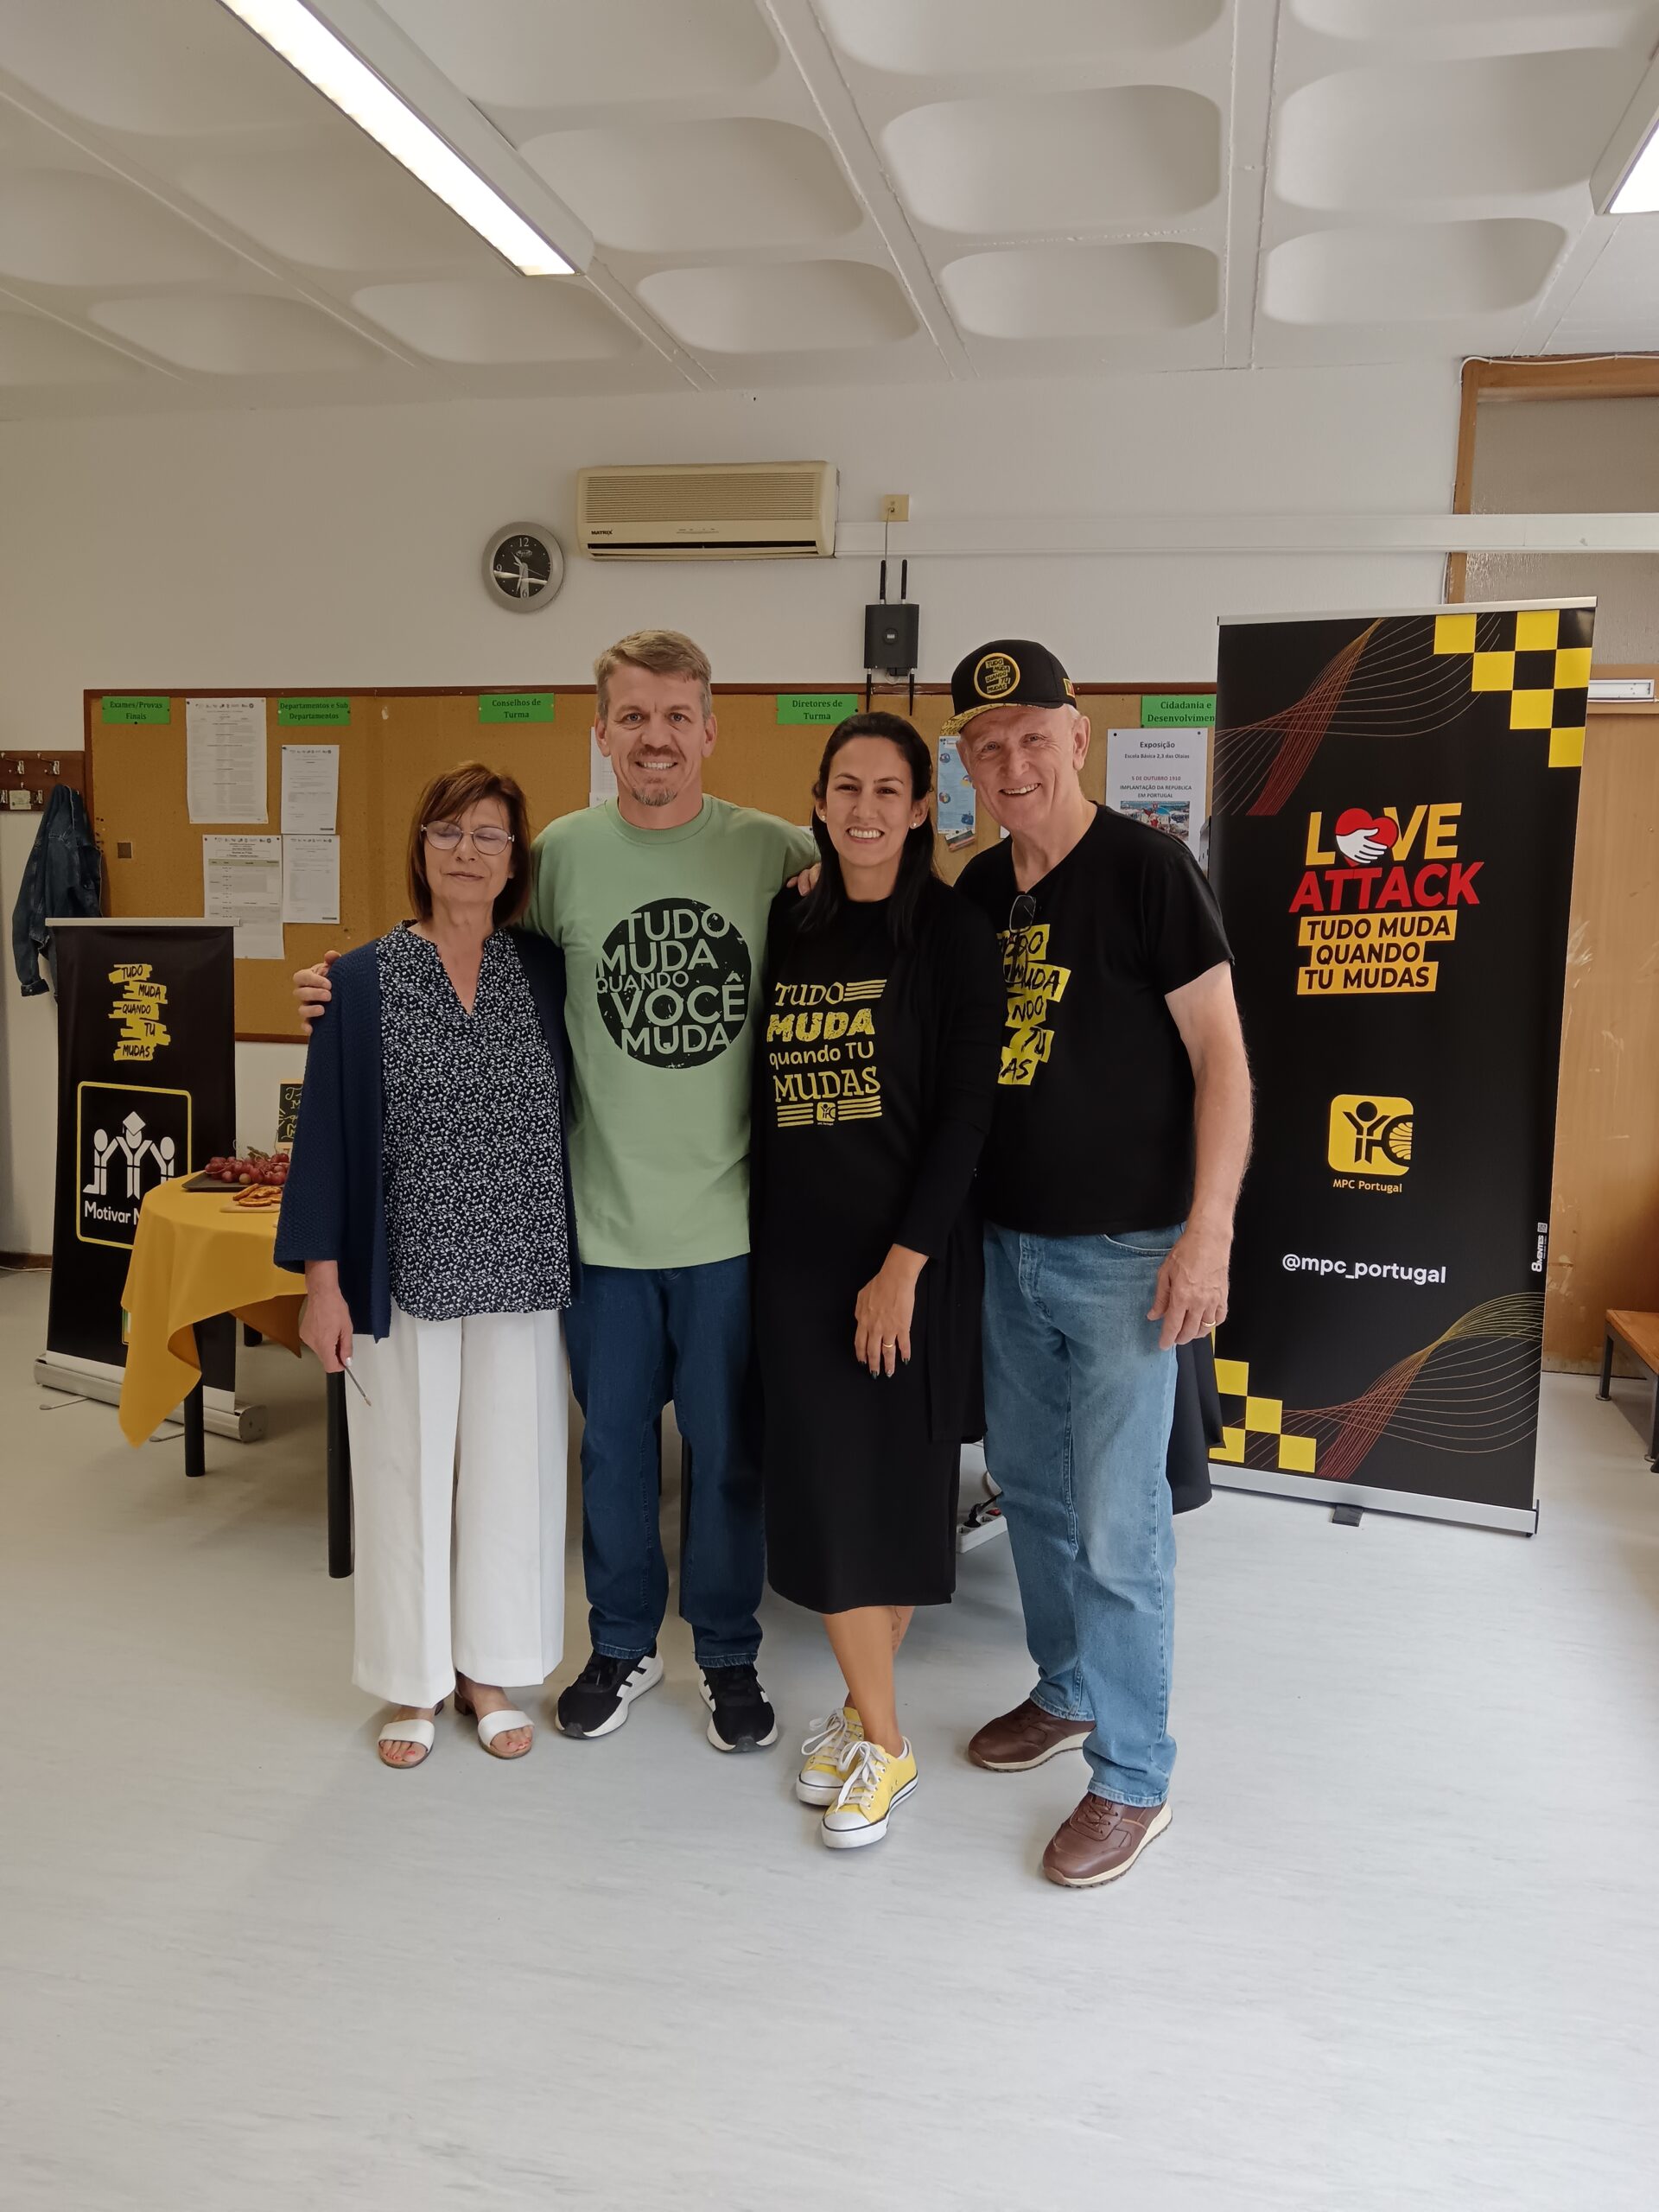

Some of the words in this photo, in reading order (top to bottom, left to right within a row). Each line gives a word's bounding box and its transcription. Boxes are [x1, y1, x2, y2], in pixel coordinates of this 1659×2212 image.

[518, 537, 529, 547] 12
[1147, 714, 1215, 722] Desenvolvimen
[1288, 861, 1484, 912] ATTACK
[627, 909, 730, 943] TUDO
[1307, 918, 1371, 940] TUDO
[1378, 915, 1451, 938] MUDA
[596, 938, 719, 977] MUDA
[1316, 942, 1420, 965] QUANDO
[122, 964, 143, 979] TUDO
[596, 970, 690, 994] QUANDO
[1305, 969, 1333, 989] TU
[1343, 966, 1430, 988] MUDAS
[138, 983, 161, 1000] MUDA
[610, 972, 745, 1028] VOCÊ
[775, 982, 844, 1007] TUDO
[122, 1004, 151, 1014] QUANDO
[1012, 995, 1044, 1022] NDO
[144, 1022, 156, 1036] TU
[766, 1007, 875, 1042] MUDA
[621, 1022, 731, 1055] MUDA
[1021, 1027, 1046, 1058] TU
[123, 1045, 150, 1058] MUDAS
[769, 1045, 841, 1070] quando
[845, 1040, 874, 1059] TU
[772, 1065, 881, 1103] MUDAS
[1333, 1179, 1355, 1189] MPC
[1358, 1180, 1402, 1194] Portugal
[84, 1200, 131, 1224] Motivar
[1282, 1253, 1446, 1285] @mpc_portugal
